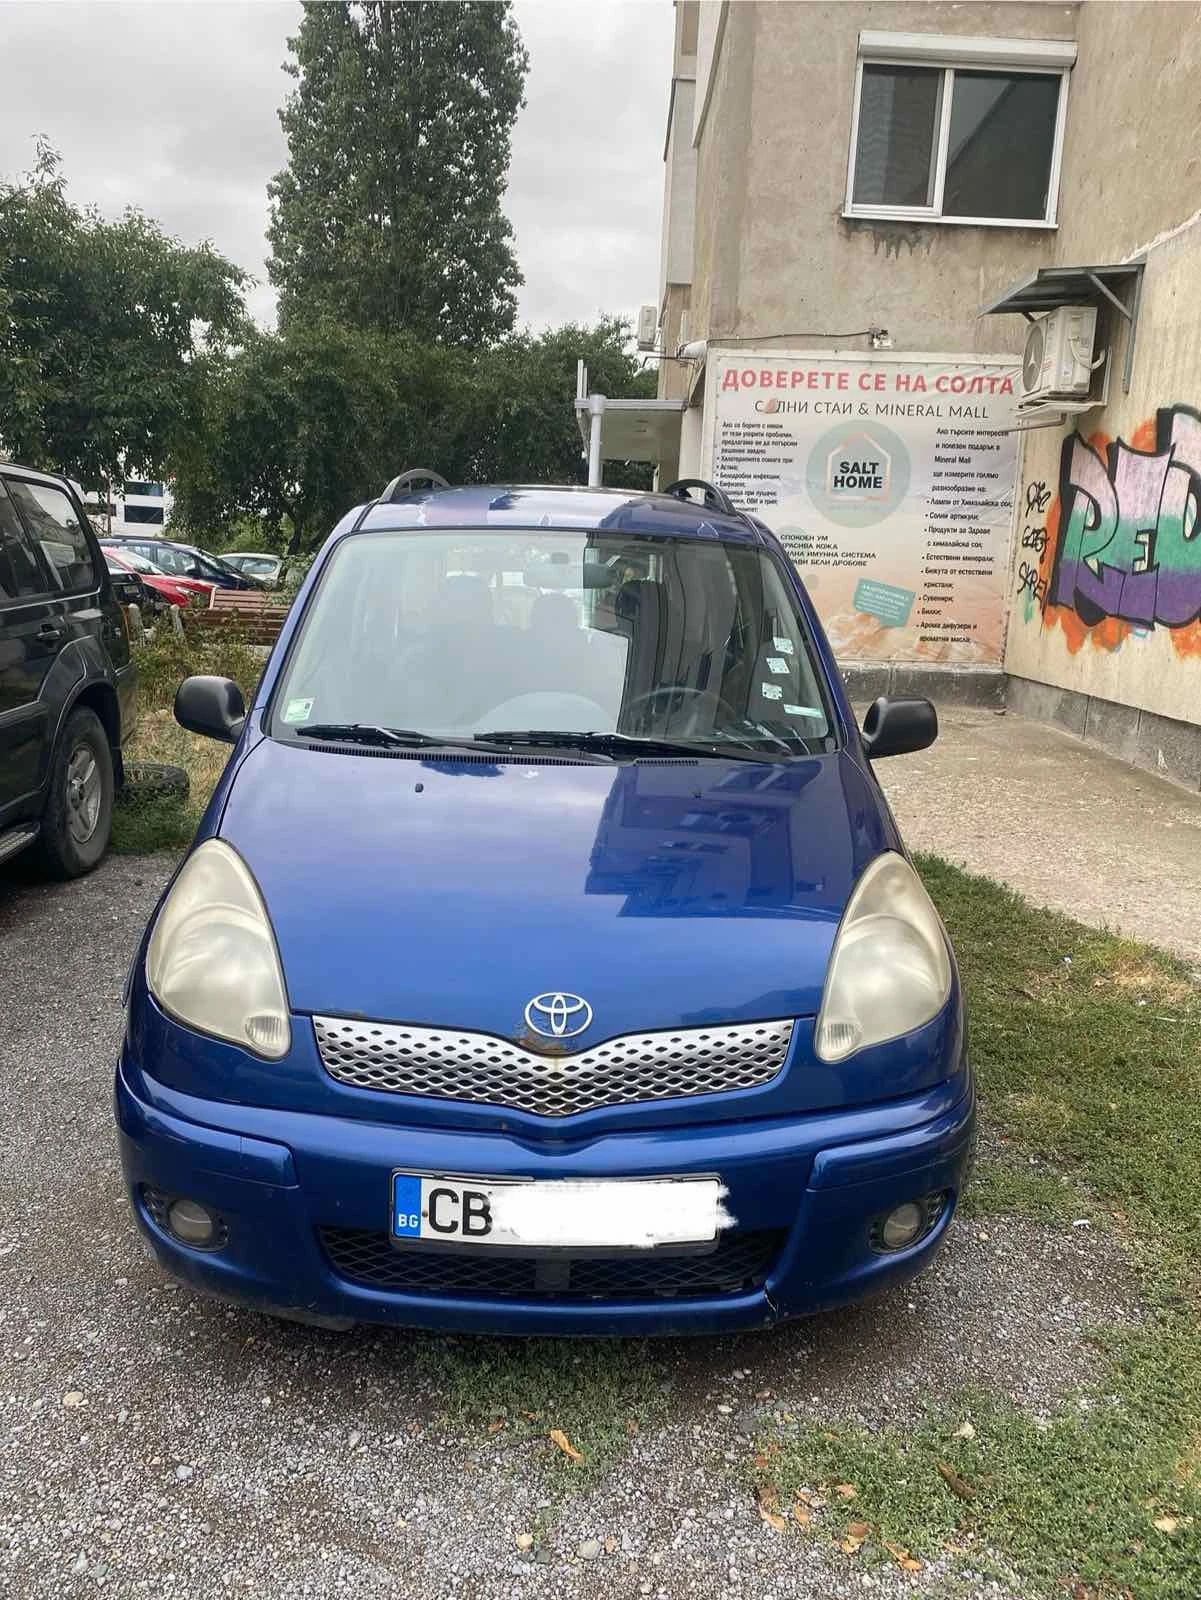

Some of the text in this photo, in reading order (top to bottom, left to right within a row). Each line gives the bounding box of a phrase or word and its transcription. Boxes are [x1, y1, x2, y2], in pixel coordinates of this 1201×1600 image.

[722, 368, 1014, 395] ДОВЕРЕТЕ СЕ НА СОЛТА
[755, 399, 989, 418] СЛНИ СТАИ & MINERAL MALL
[936, 427, 949, 435] Ако
[950, 429, 975, 437] търсите
[934, 455, 972, 464] Mineral Mall
[839, 461, 880, 475] SALT
[833, 475, 883, 489] HOME
[928, 526, 957, 535] Продукти
[968, 526, 991, 535] Здраве
[841, 551, 877, 559] СИСТЕМА
[926, 553, 961, 561] Естествени
[924, 567, 948, 576] Бижута
[428, 1187, 492, 1237] CB
[397, 1213, 419, 1228] BG
